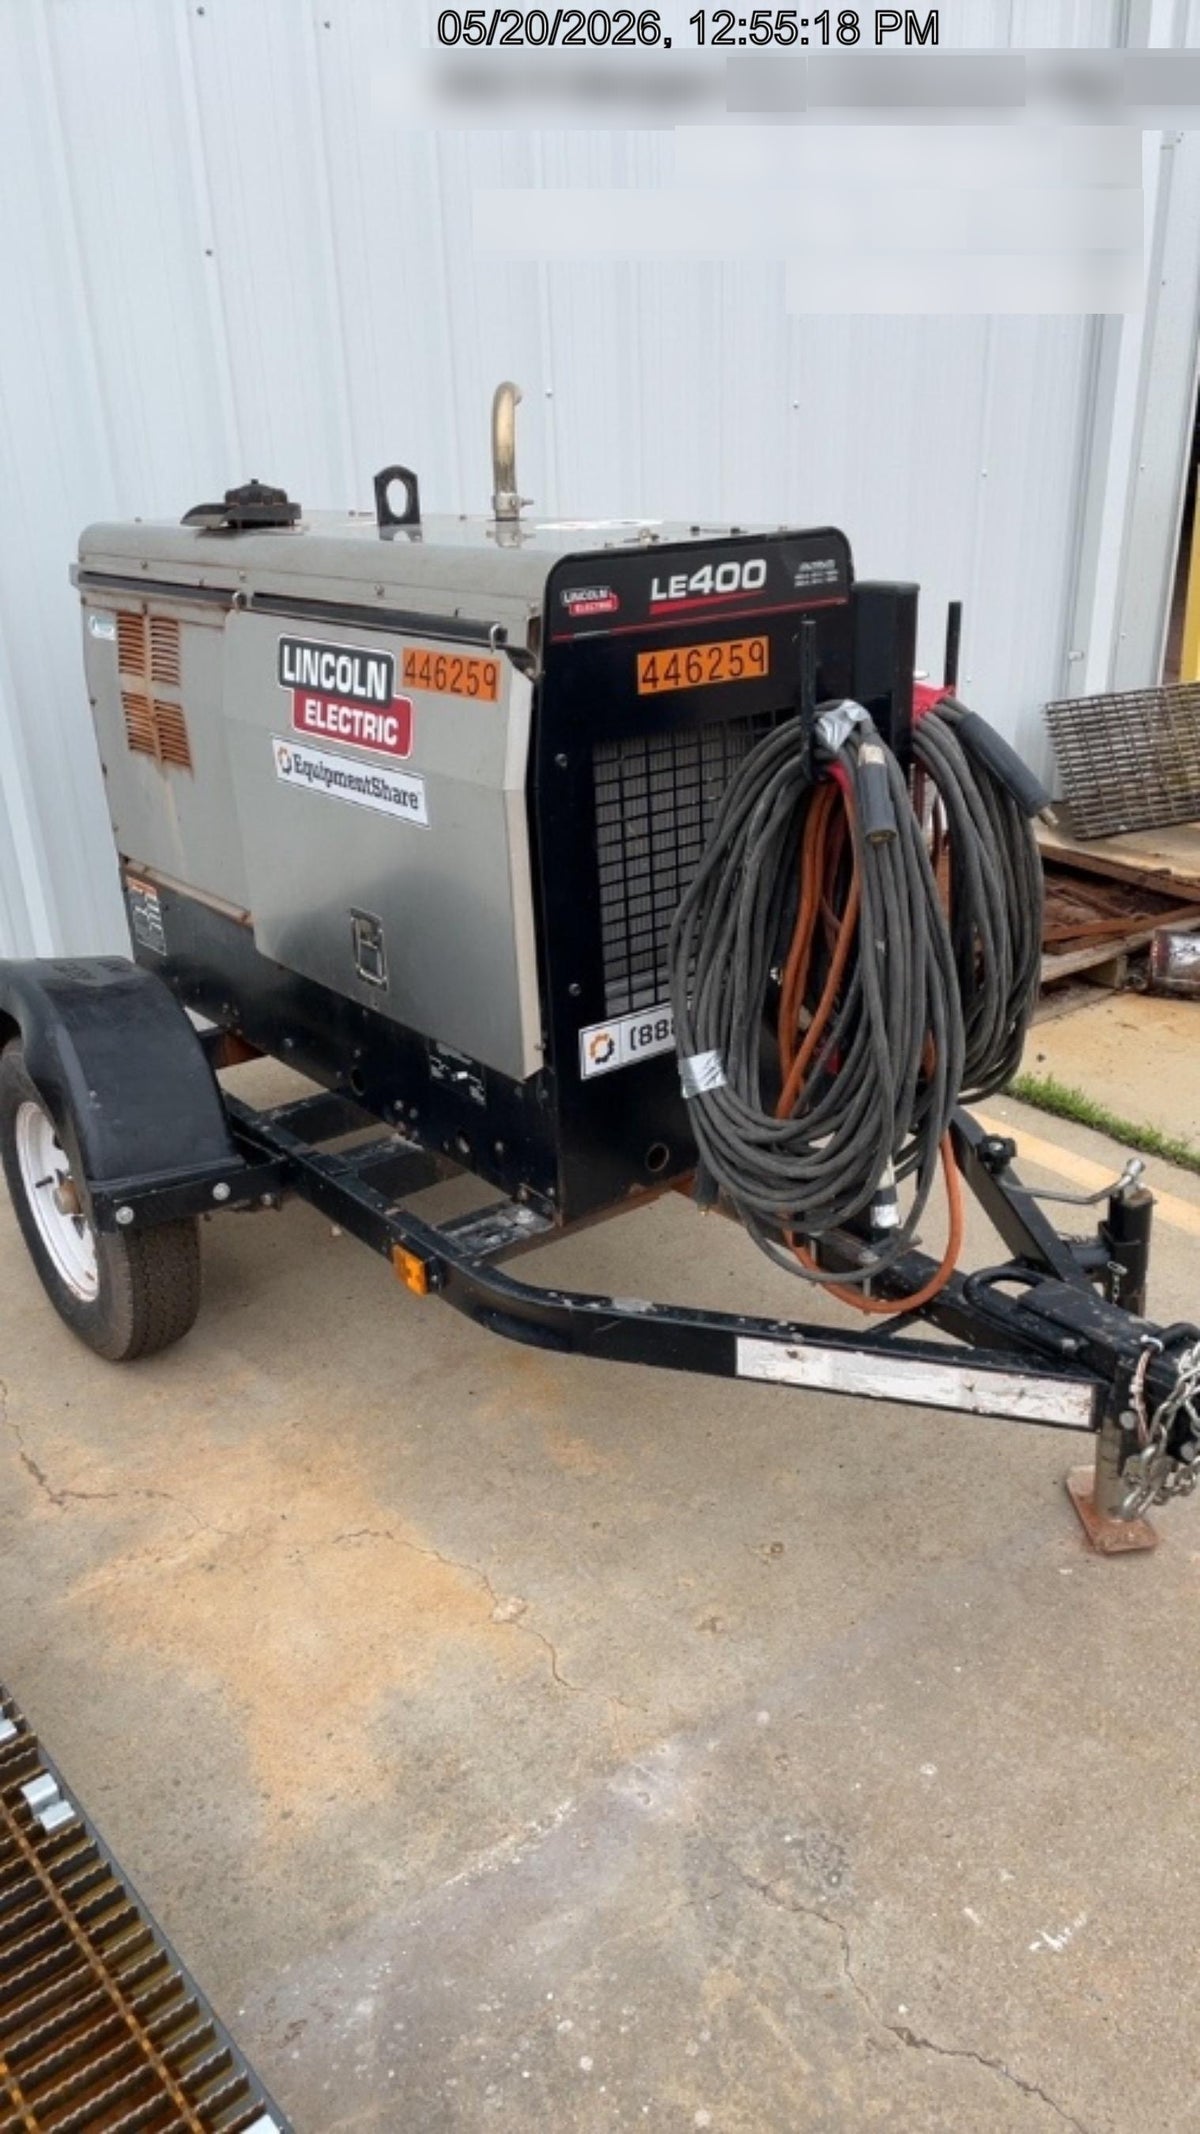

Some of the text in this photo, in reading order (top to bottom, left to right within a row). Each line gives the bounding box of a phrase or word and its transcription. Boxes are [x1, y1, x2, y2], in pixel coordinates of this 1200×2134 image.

[650, 559, 767, 600] LE400
[282, 646, 388, 700] LINCOLN
[404, 650, 498, 701] 446259
[641, 640, 766, 689] 446259
[303, 699, 399, 746] ELECTRIC
[293, 753, 420, 810] EquipmentShare
[629, 1018, 676, 1051] (88
